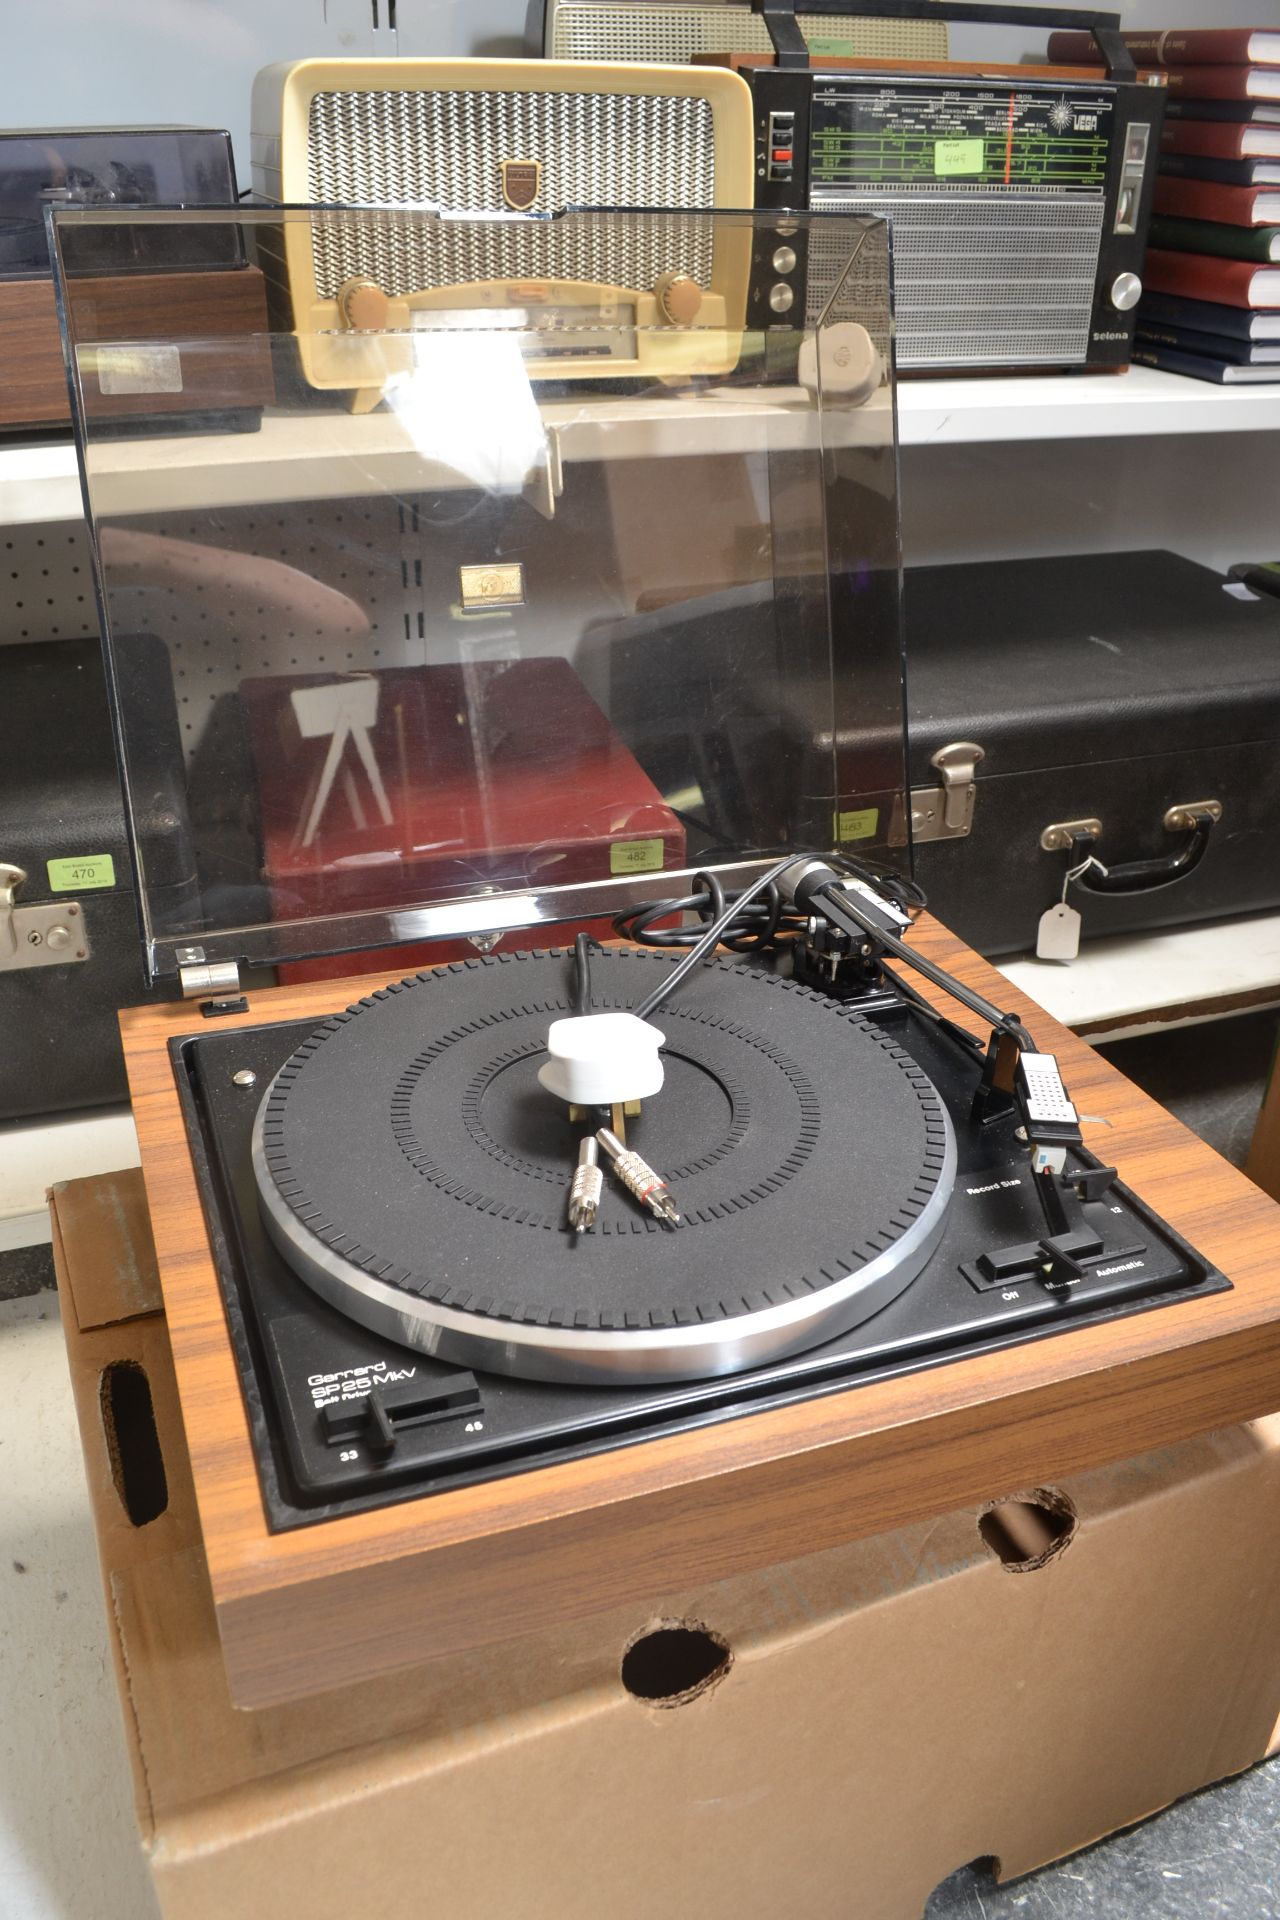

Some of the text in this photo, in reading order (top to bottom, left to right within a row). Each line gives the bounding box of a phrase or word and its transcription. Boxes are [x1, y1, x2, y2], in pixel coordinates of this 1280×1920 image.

[1093, 331, 1129, 341] selena
[627, 851, 646, 861] 482
[72, 868, 95, 879] 470
[966, 1178, 1021, 1195] Record Size
[1110, 1206, 1122, 1215] 12
[1096, 1260, 1145, 1277] Automatic
[1002, 1291, 1019, 1301] Off
[307, 1361, 387, 1386] Garrard
[465, 1421, 483, 1432] 45
[340, 1450, 359, 1461] 33
